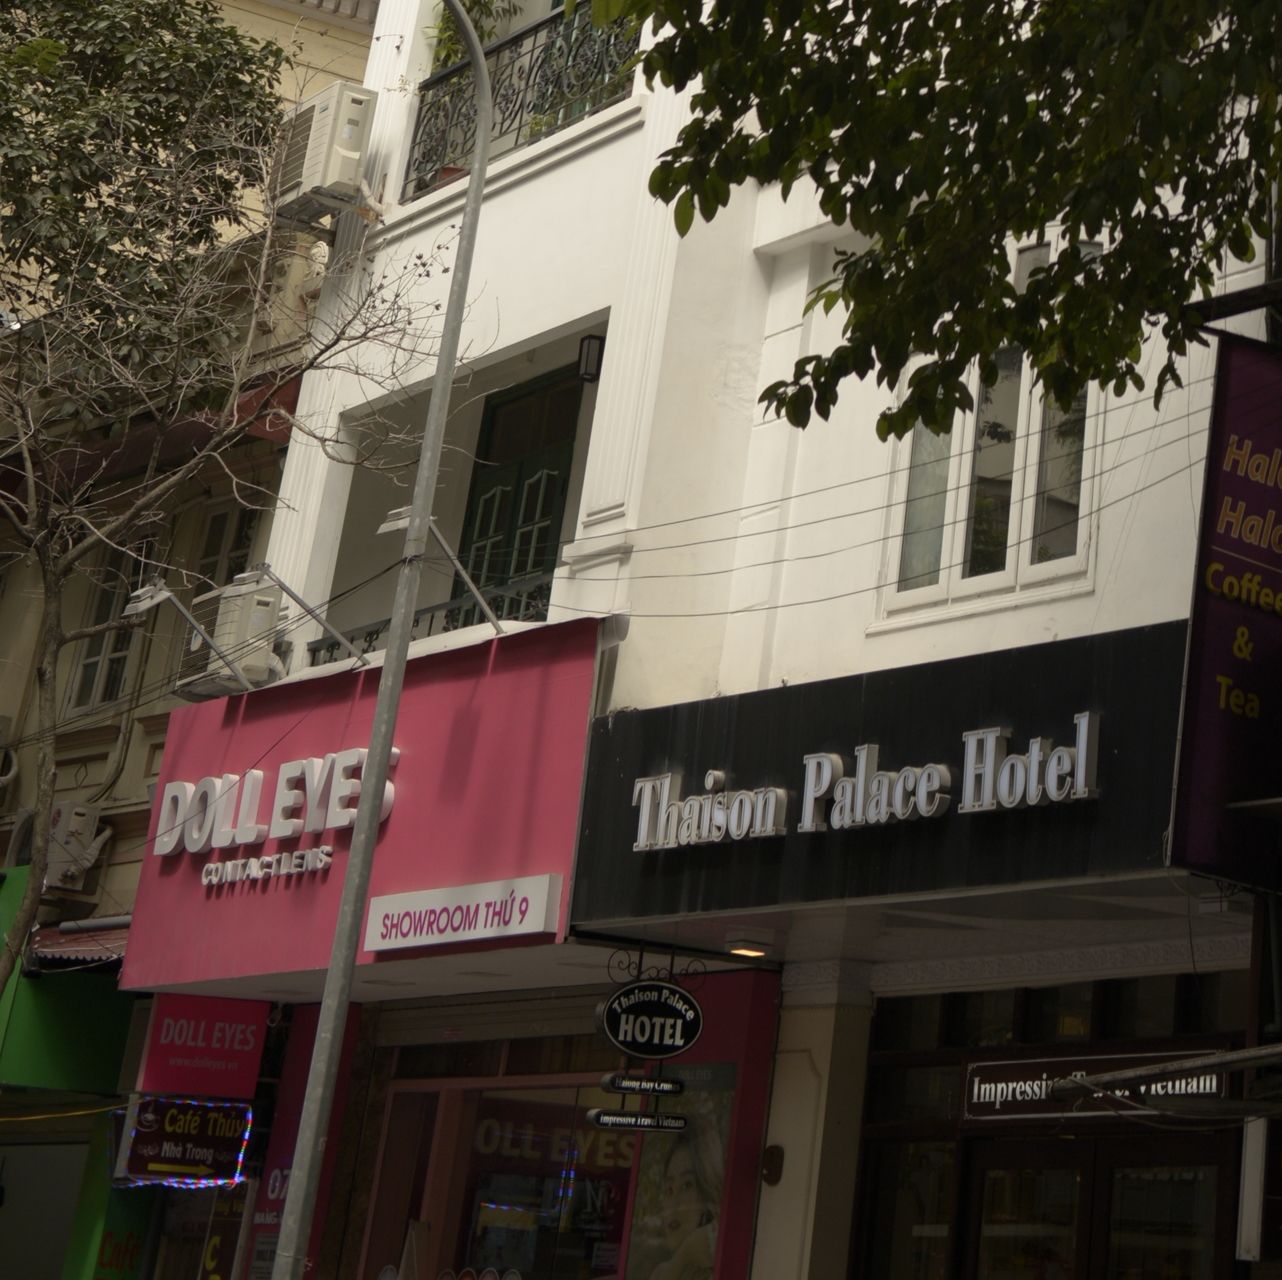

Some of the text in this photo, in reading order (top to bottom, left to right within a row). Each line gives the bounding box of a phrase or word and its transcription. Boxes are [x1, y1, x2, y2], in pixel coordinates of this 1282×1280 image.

[1232, 625, 1254, 662] &
[1215, 674, 1263, 719] Tea
[632, 711, 1098, 852] Thaison Palace Hotel
[153, 769, 268, 856] DOLL
[380, 889, 529, 940] SHOWROOM THỨ 9
[612, 988, 695, 1021] Thaison Palace
[160, 1017, 257, 1051] DOLL EYES
[618, 1013, 686, 1047] HOTEL
[971, 1072, 1062, 1109] Impressi
[164, 1108, 201, 1135] Café
